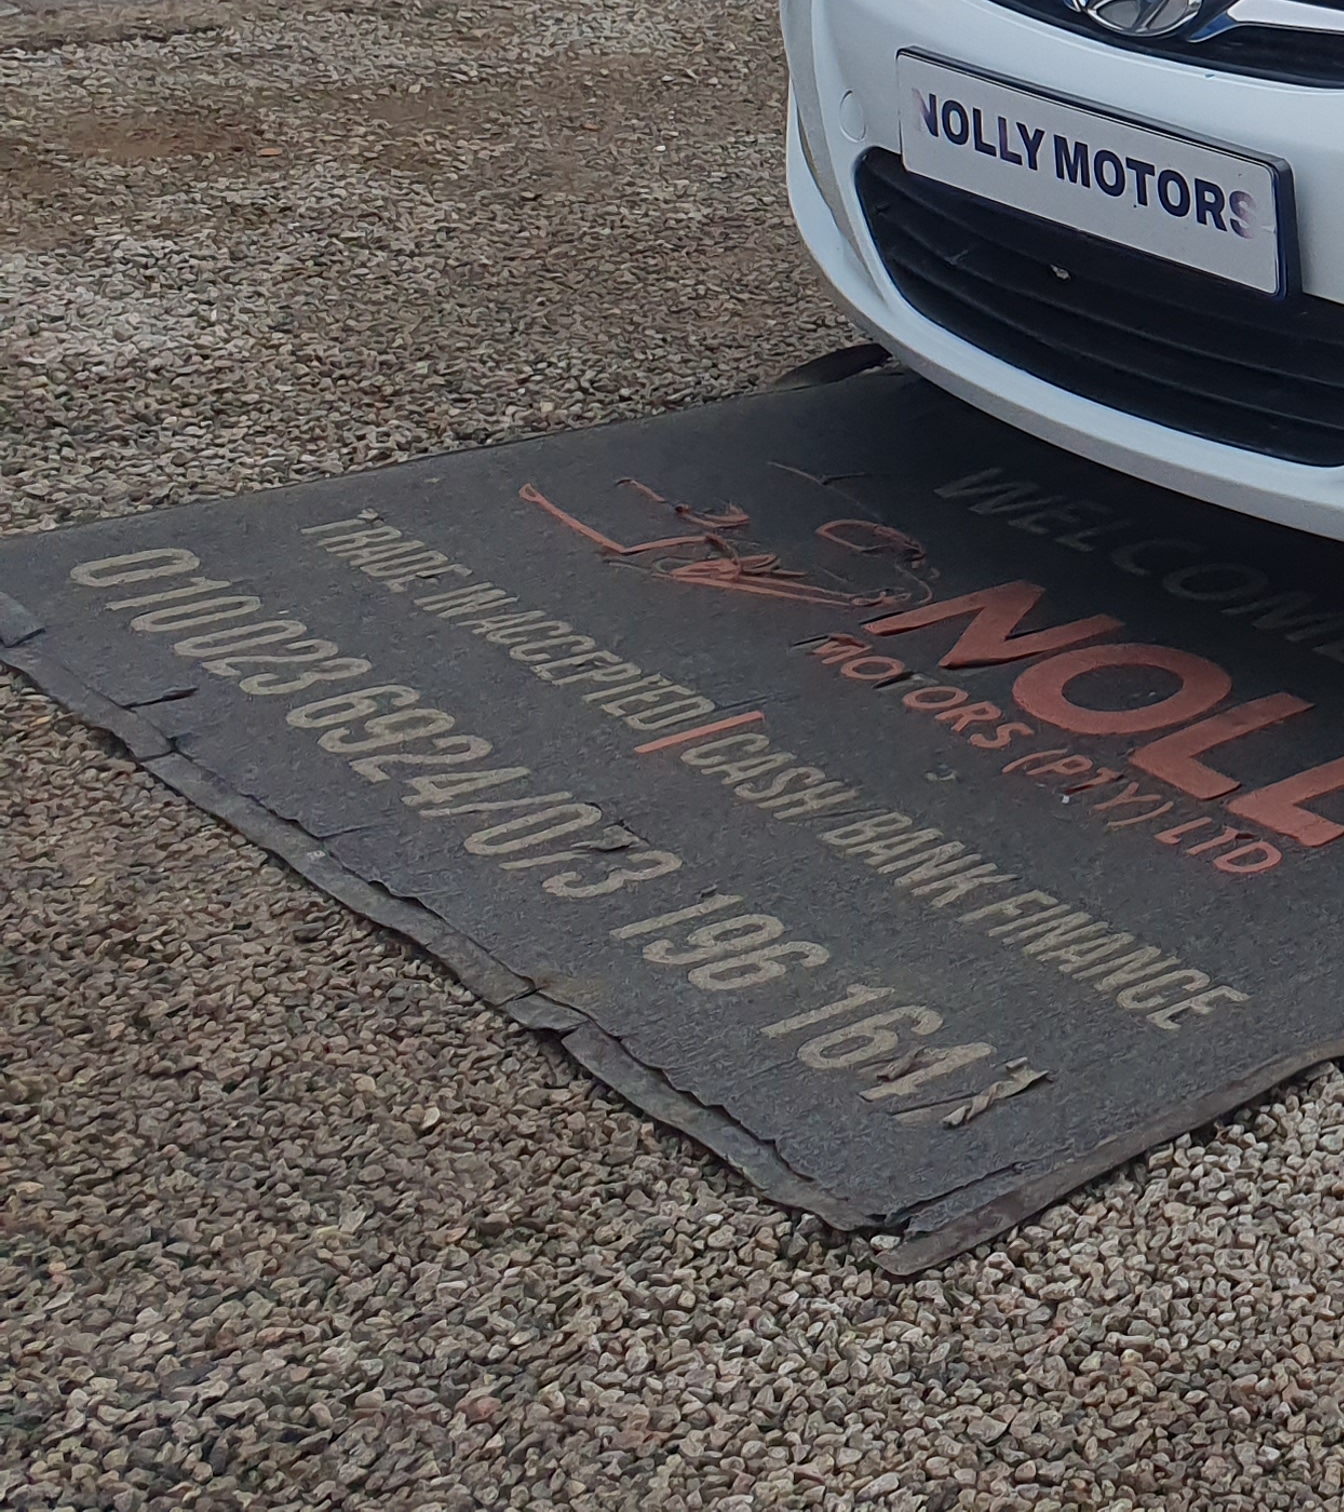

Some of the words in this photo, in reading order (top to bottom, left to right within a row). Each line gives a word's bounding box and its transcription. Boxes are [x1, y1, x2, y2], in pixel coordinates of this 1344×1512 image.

[912, 87, 1045, 172] NOLLY
[1053, 133, 1258, 240] MOTORS
[300, 508, 473, 593] TRADE
[412, 580, 520, 619] IN
[455, 608, 716, 732] ACCEPTED
[172, 619, 374, 697] 023
[609, 893, 832, 991] 196
[1153, 816, 1283, 875] LTD
[957, 889, 1250, 1031] FINANCE
